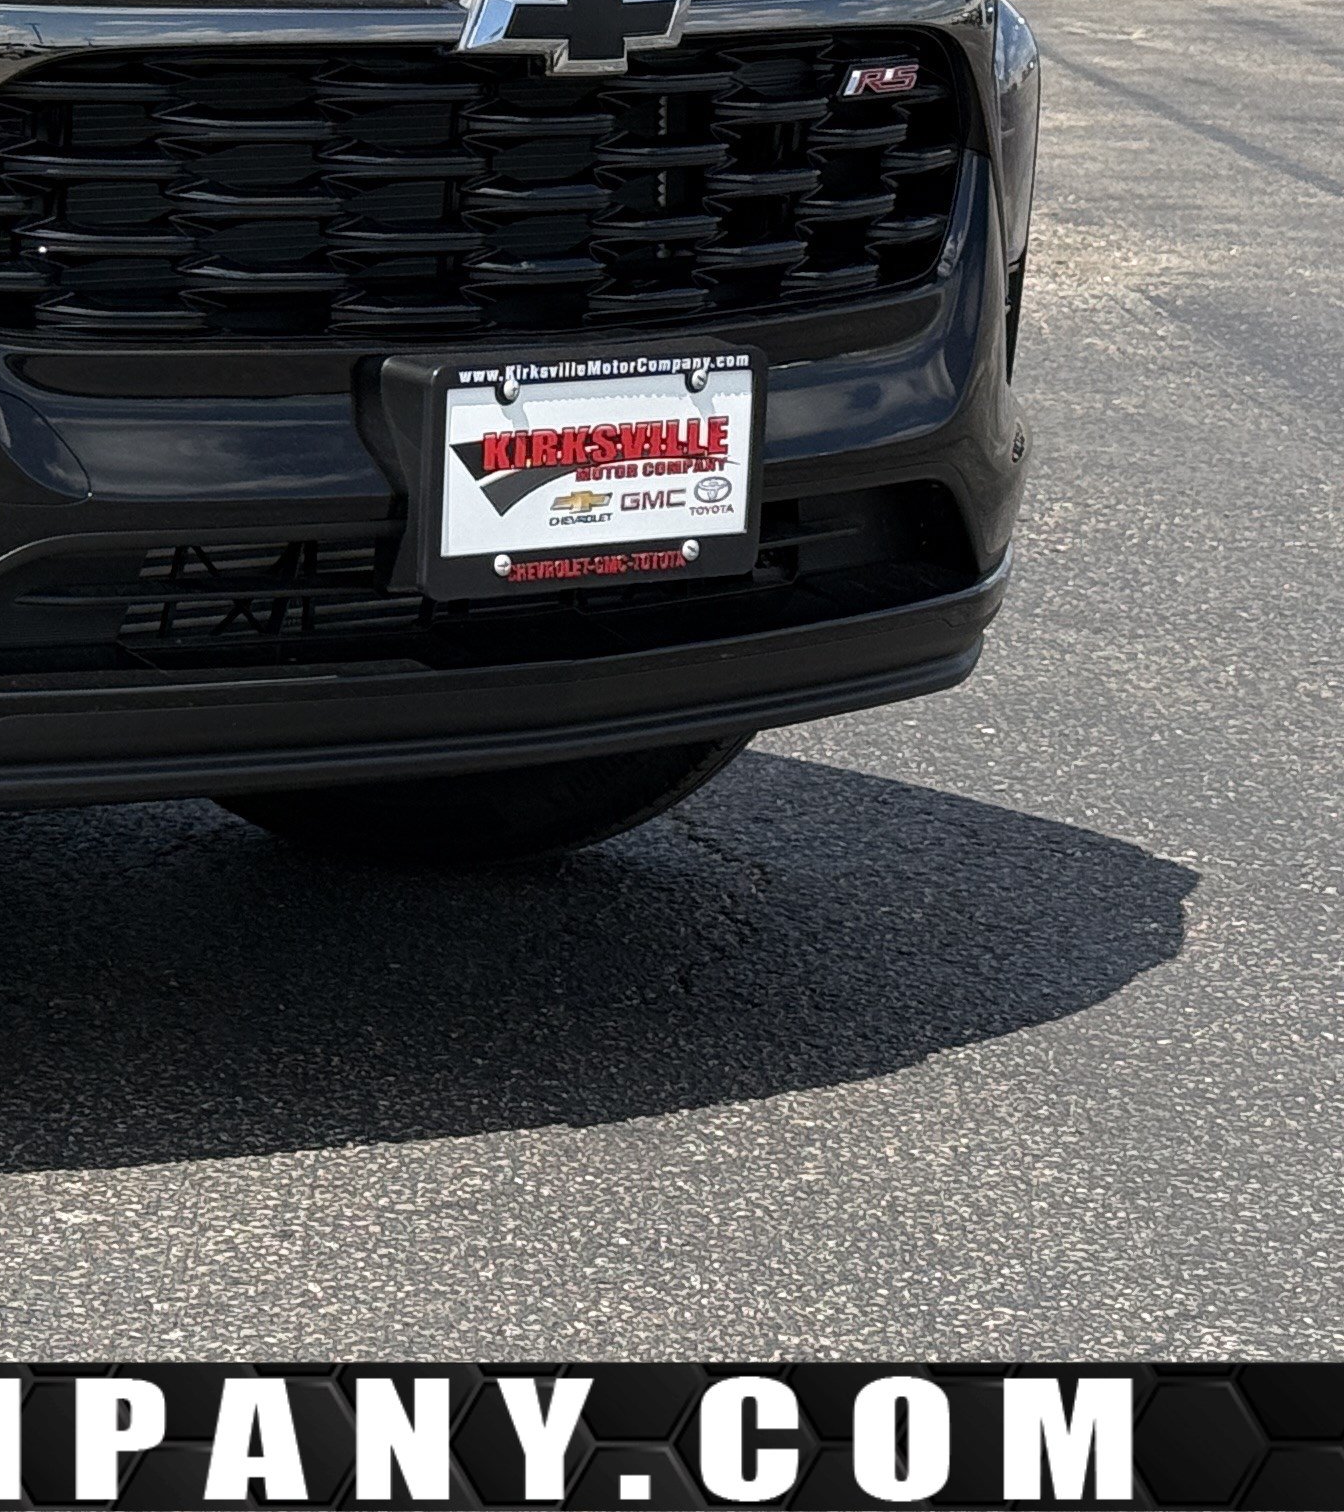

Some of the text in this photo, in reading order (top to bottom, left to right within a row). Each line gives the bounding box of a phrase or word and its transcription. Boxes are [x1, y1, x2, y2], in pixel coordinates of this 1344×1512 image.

[843, 64, 919, 96] RS
[459, 354, 750, 384] www.KirksvilleMotorCompany.com
[483, 416, 729, 471] KIRKSVILLE
[575, 457, 728, 482] MOTOR COMPANY
[620, 488, 687, 511] GMC
[689, 503, 735, 516] TOYOTA
[549, 512, 613, 527] CHEVROLET
